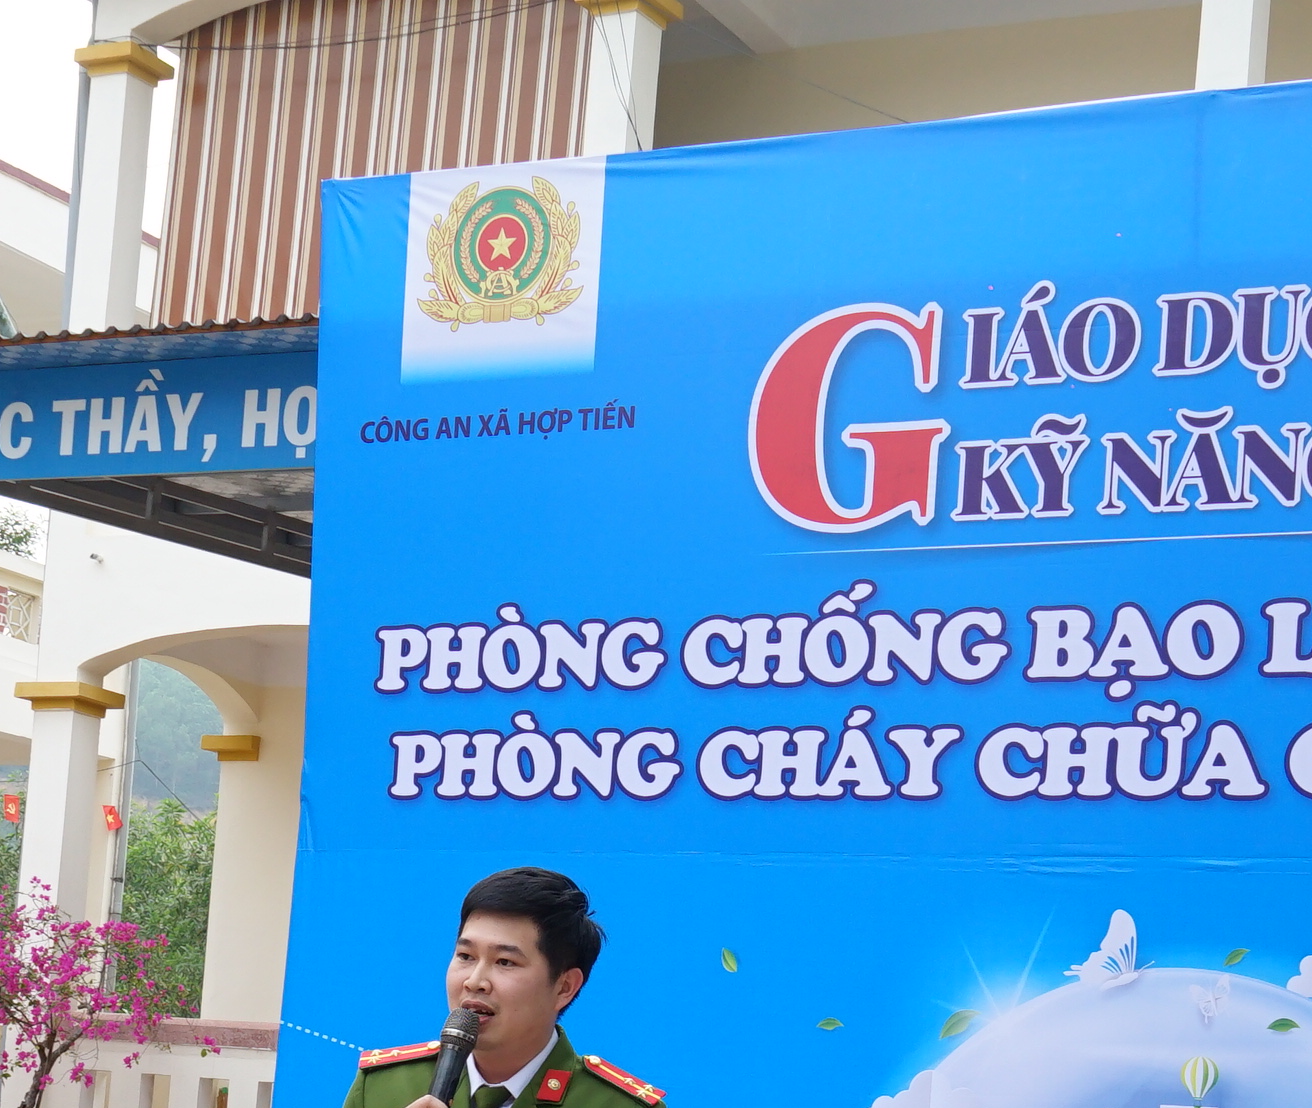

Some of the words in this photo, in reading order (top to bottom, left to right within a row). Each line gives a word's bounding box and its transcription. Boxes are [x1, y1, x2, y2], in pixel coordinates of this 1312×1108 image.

[52, 368, 218, 462] THẦY,
[360, 415, 429, 444] CÔNG
[435, 415, 472, 440] AN
[477, 408, 511, 437] XÃ
[518, 407, 573, 441] HỢP
[578, 398, 636, 431] TIẾN
[952, 413, 1086, 522] KỸ
[376, 603, 667, 693] PHÒNG
[684, 579, 1009, 687] CHỐNG
[1024, 600, 1244, 701] BẠO
[390, 709, 683, 801] PHÒNG
[696, 706, 960, 801] CHÁY
[976, 700, 1267, 802] CHỮA
